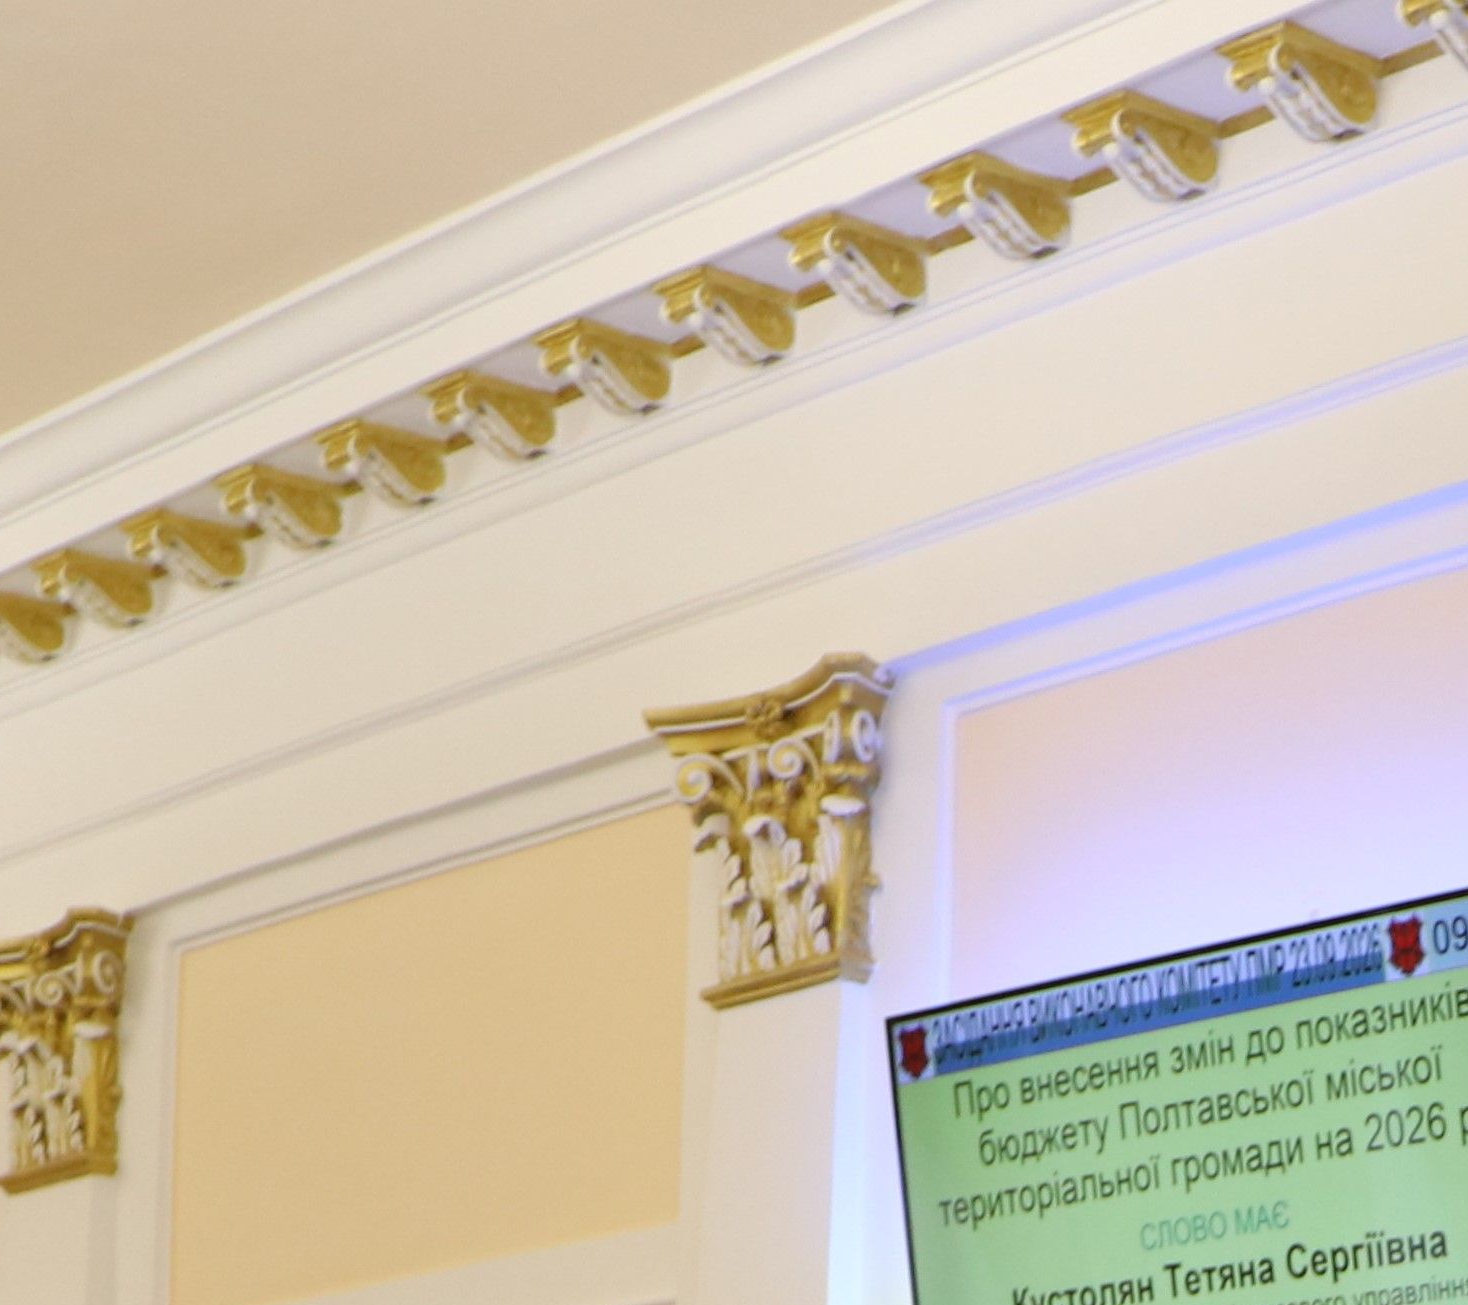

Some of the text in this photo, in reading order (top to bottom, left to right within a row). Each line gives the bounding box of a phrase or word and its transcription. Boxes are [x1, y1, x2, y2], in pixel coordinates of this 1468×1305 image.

[1247, 944, 1283, 998] ПМР
[953, 1079, 1011, 1122] Про
[1020, 1050, 1161, 1104] внесення
[1170, 1029, 1235, 1074] змін
[1245, 1025, 1285, 1066] до
[979, 1044, 1444, 1167] бюджету Полтавської міської
[939, 1154, 1161, 1231] територіальної
[1171, 1136, 1305, 1194] громади
[1316, 1126, 1355, 1161] на
[1364, 1102, 1447, 1152] 2026
[1140, 1200, 1290, 1251] СЛОВО МАЄ
[1163, 1255, 1276, 1299] Тетяна
[1286, 1229, 1449, 1283] Сергіївна
